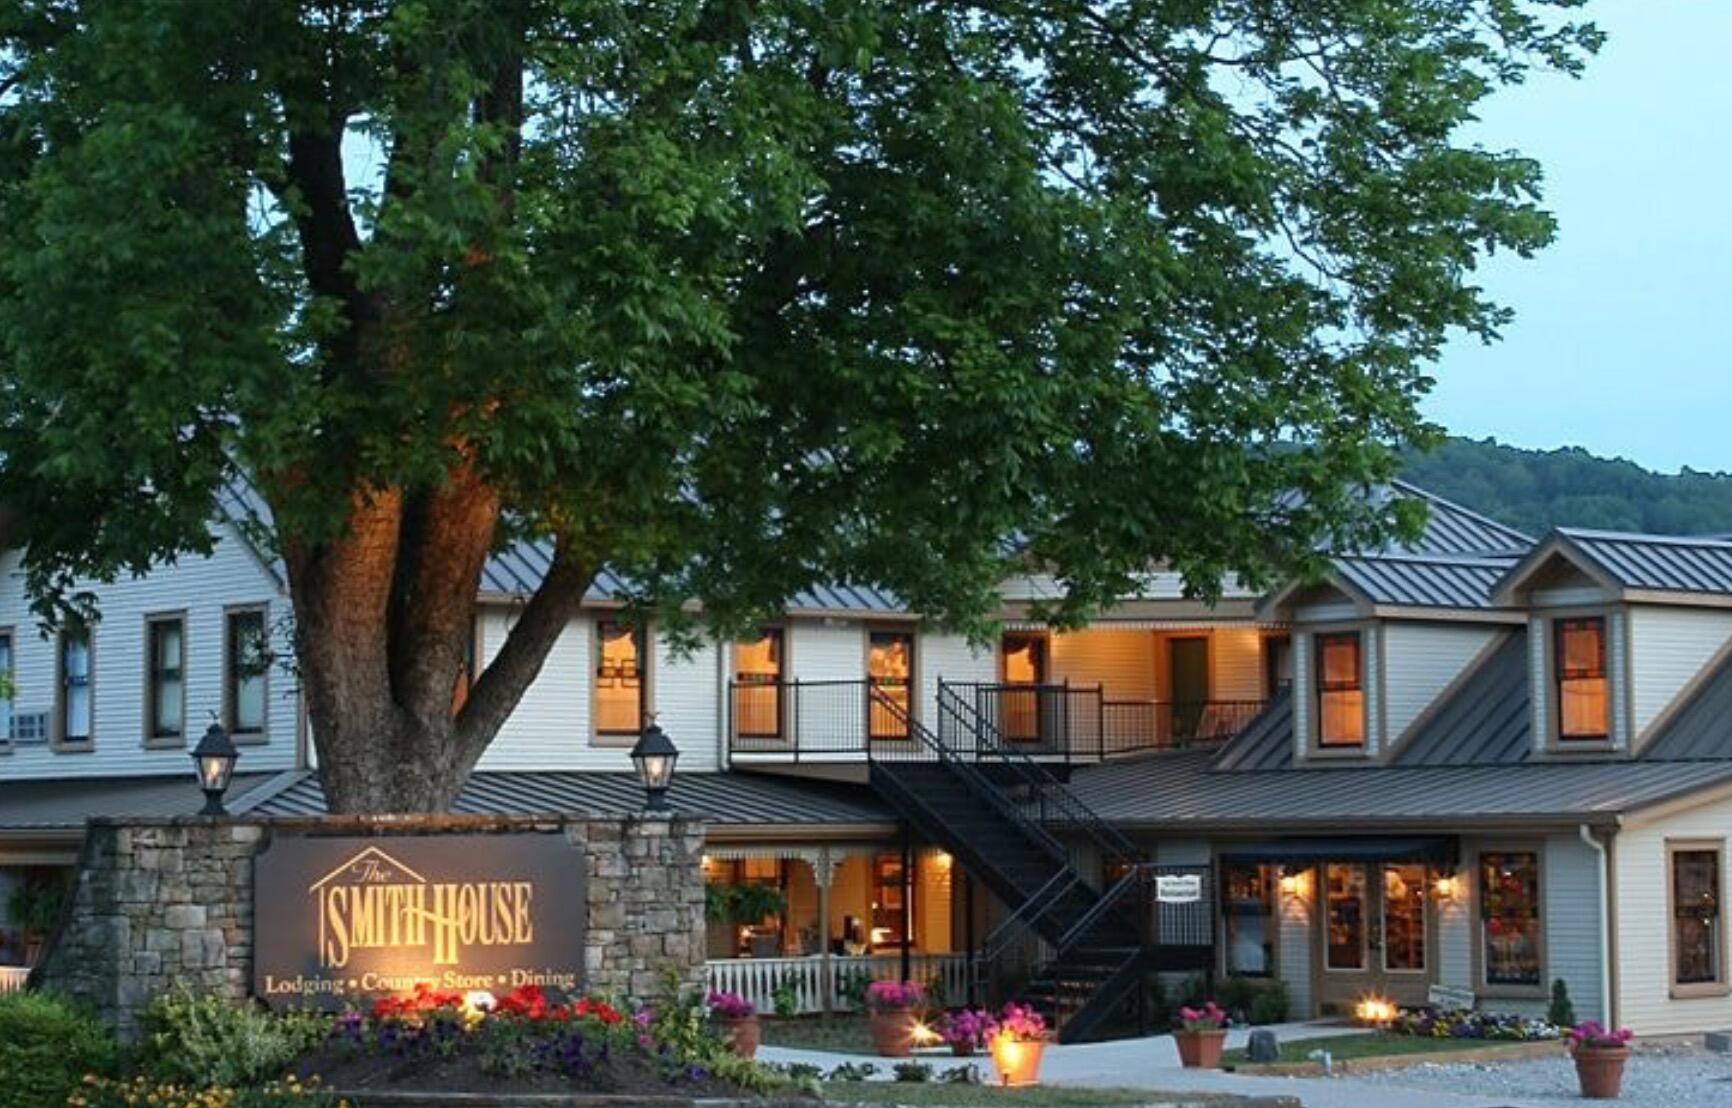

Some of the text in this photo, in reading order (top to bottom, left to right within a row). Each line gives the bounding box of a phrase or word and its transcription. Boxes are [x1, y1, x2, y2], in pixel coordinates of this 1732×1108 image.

[352, 860, 392, 882] The
[328, 882, 533, 968] SMITH HOUSE
[266, 974, 345, 996] Lodging
[443, 970, 493, 988] Store
[510, 968, 576, 991] Dining
